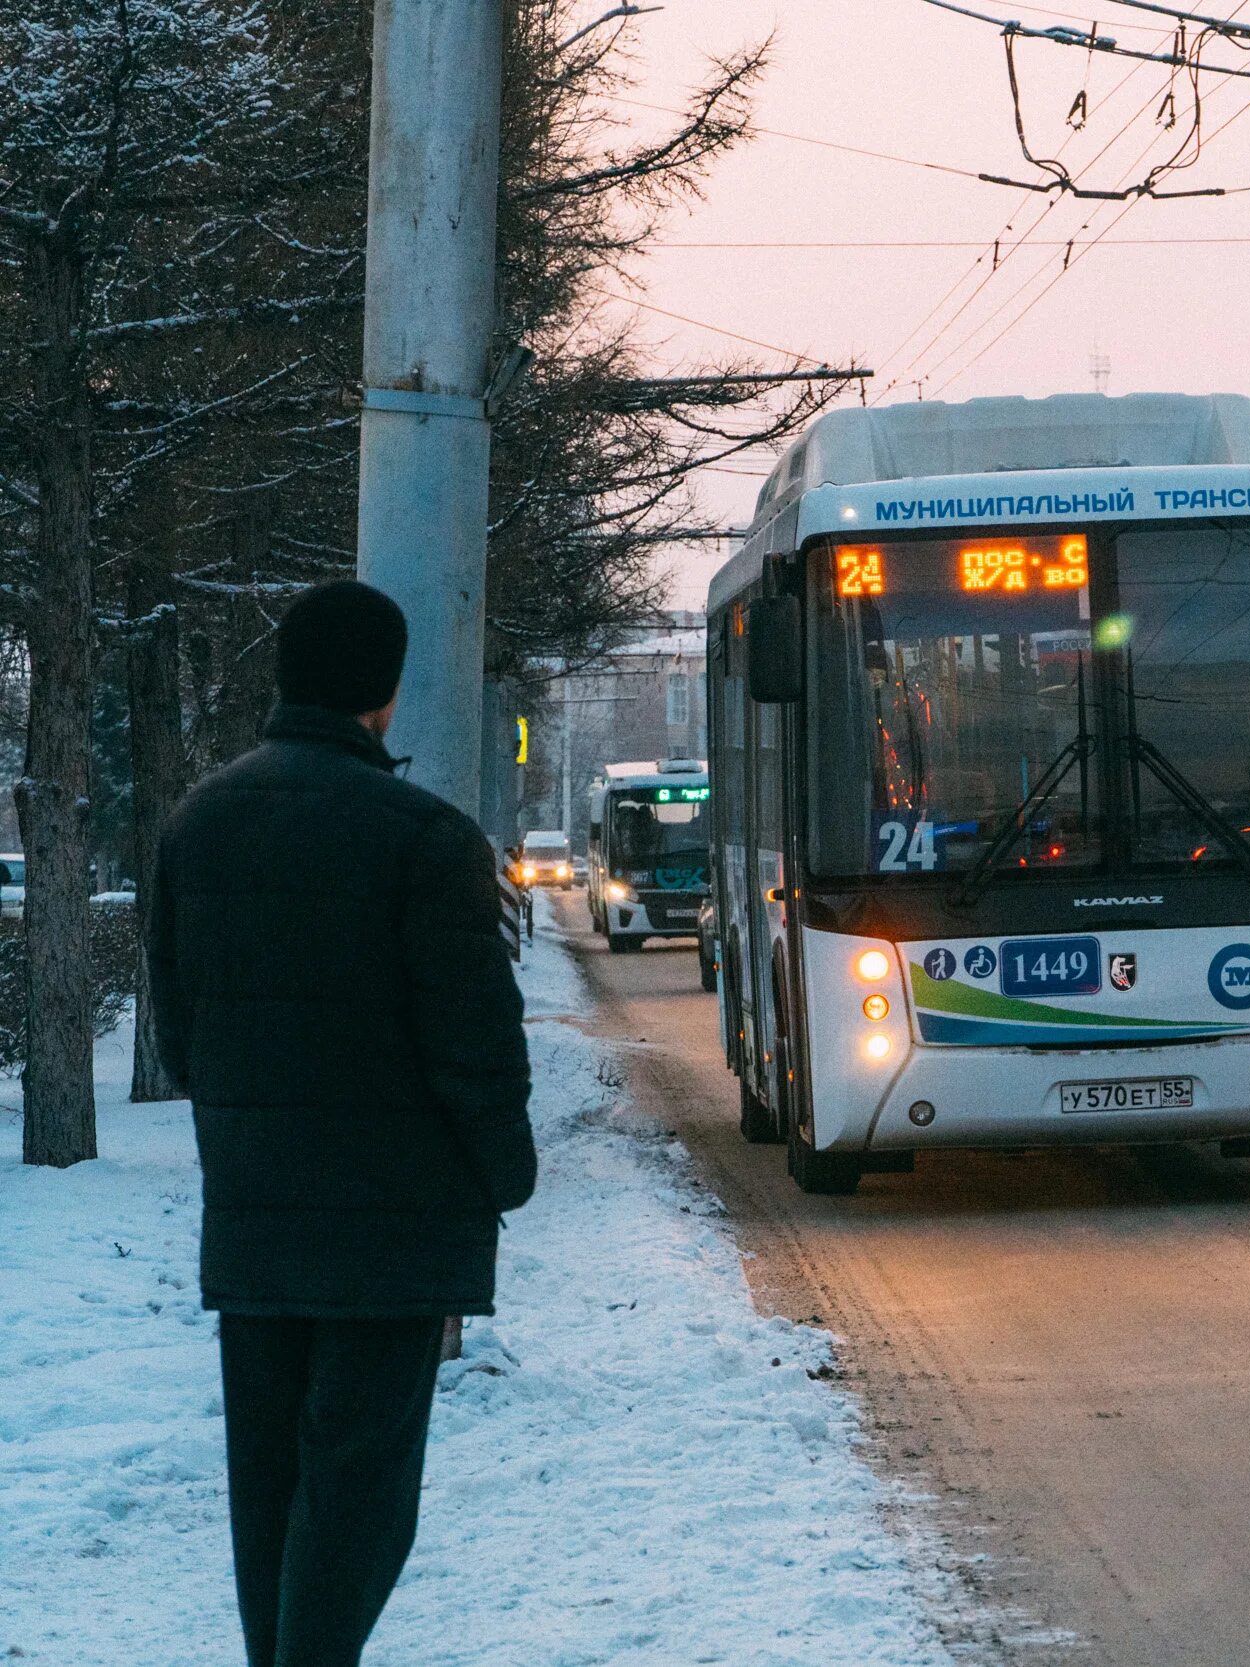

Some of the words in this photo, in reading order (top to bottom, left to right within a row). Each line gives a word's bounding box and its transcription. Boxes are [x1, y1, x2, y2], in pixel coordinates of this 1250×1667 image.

[876, 487, 1135, 520] МУНИЦИПАЛЬНЫЙ
[841, 554, 882, 593] 24
[879, 821, 938, 871] 24
[1074, 896, 1163, 907] KAMAZ
[1014, 951, 1088, 983] 1449
[1163, 1082, 1184, 1098] 55
